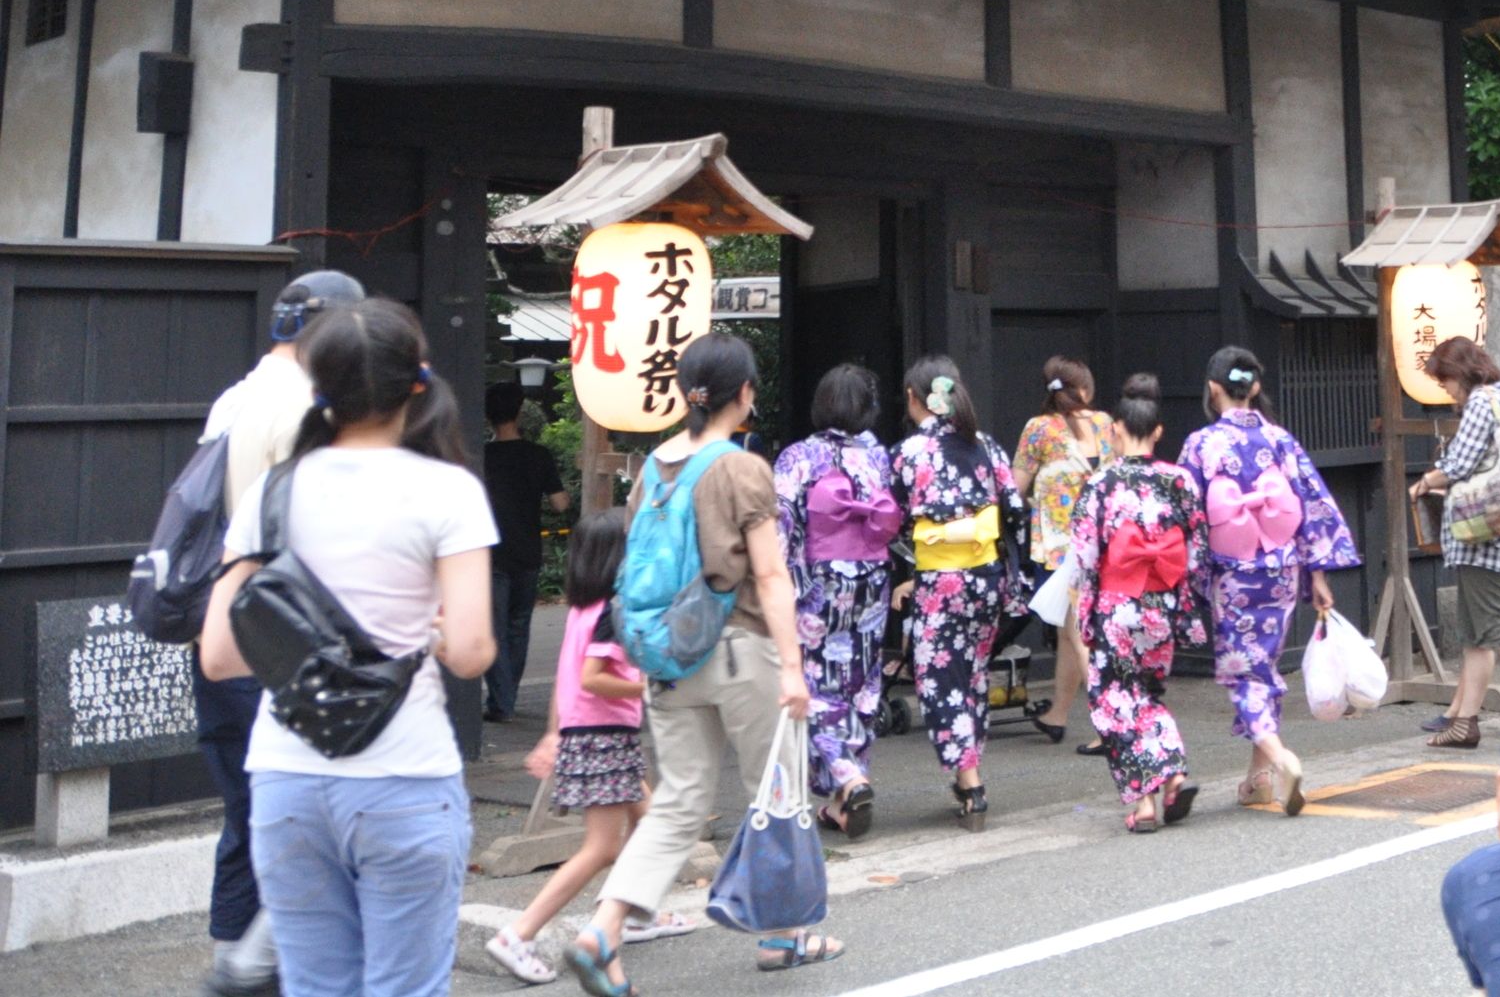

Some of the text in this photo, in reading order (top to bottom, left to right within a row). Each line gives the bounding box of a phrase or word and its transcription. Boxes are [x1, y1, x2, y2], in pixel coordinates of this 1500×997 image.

[570, 265, 626, 374] 祝
[637, 242, 694, 416] ホタル祭り
[708, 286, 780, 312] 観賞コー
